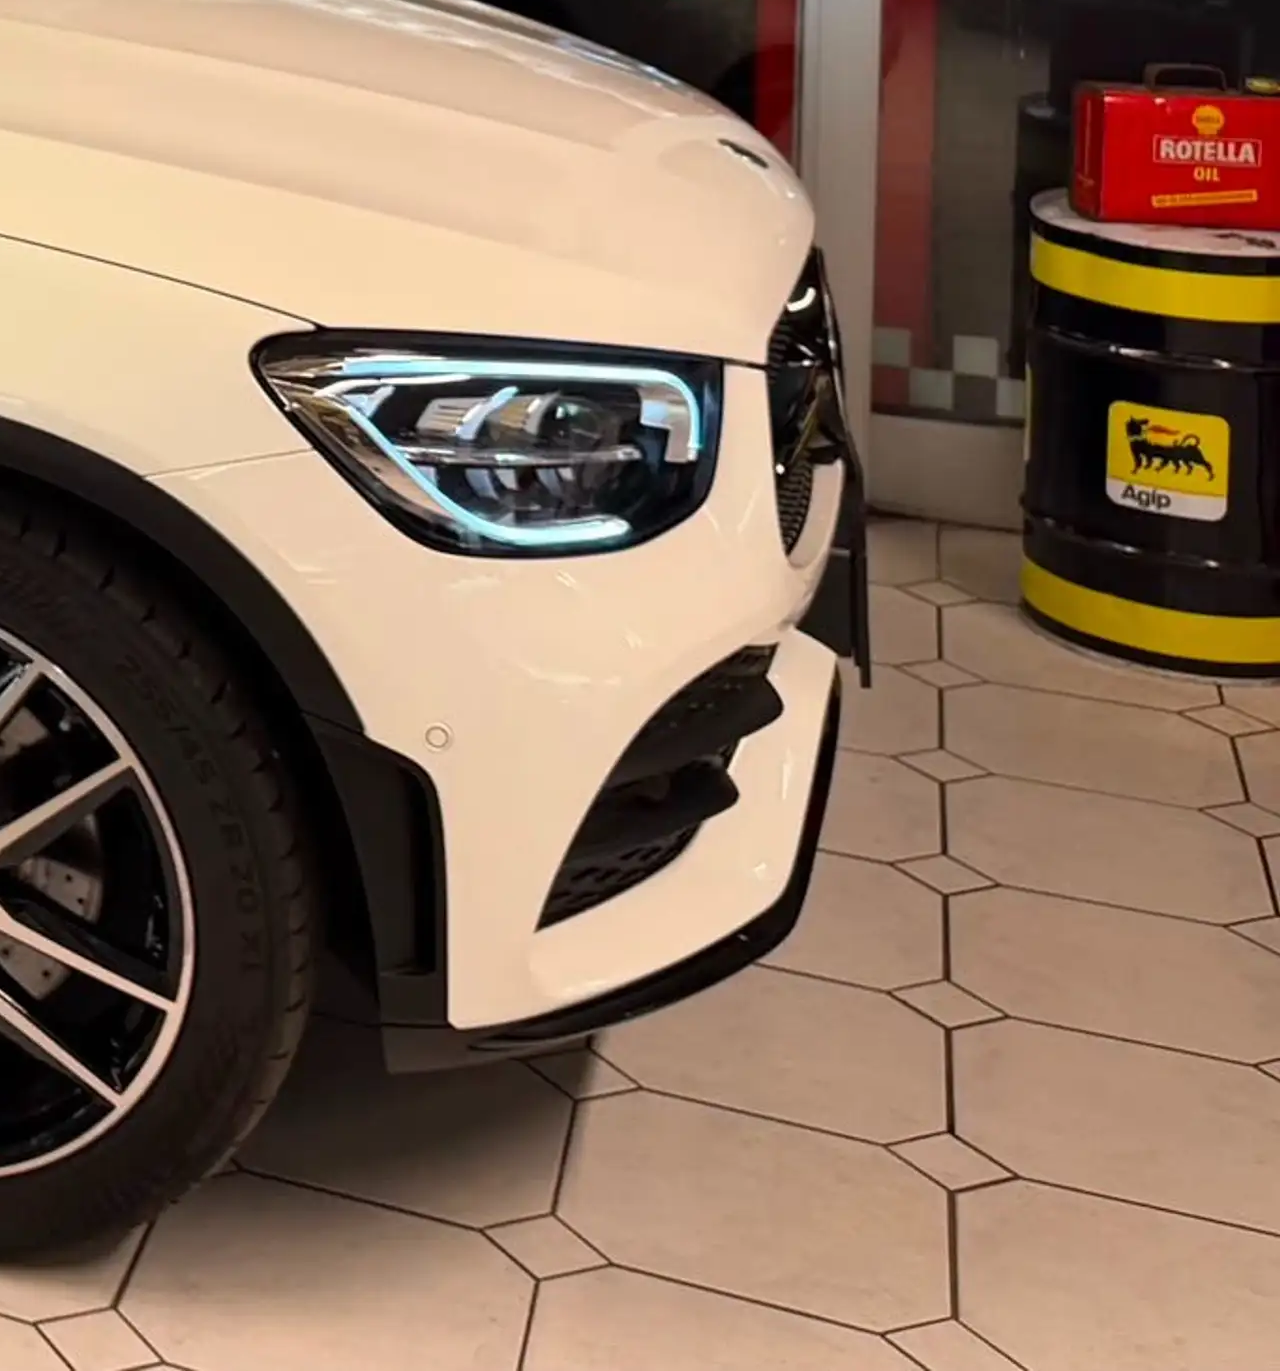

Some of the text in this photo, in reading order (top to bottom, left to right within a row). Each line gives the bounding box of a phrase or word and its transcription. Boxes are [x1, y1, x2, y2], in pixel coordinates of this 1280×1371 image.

[1159, 138, 1256, 163] ROTELLA
[1193, 166, 1221, 182] OIL
[1122, 484, 1171, 509] Agip
